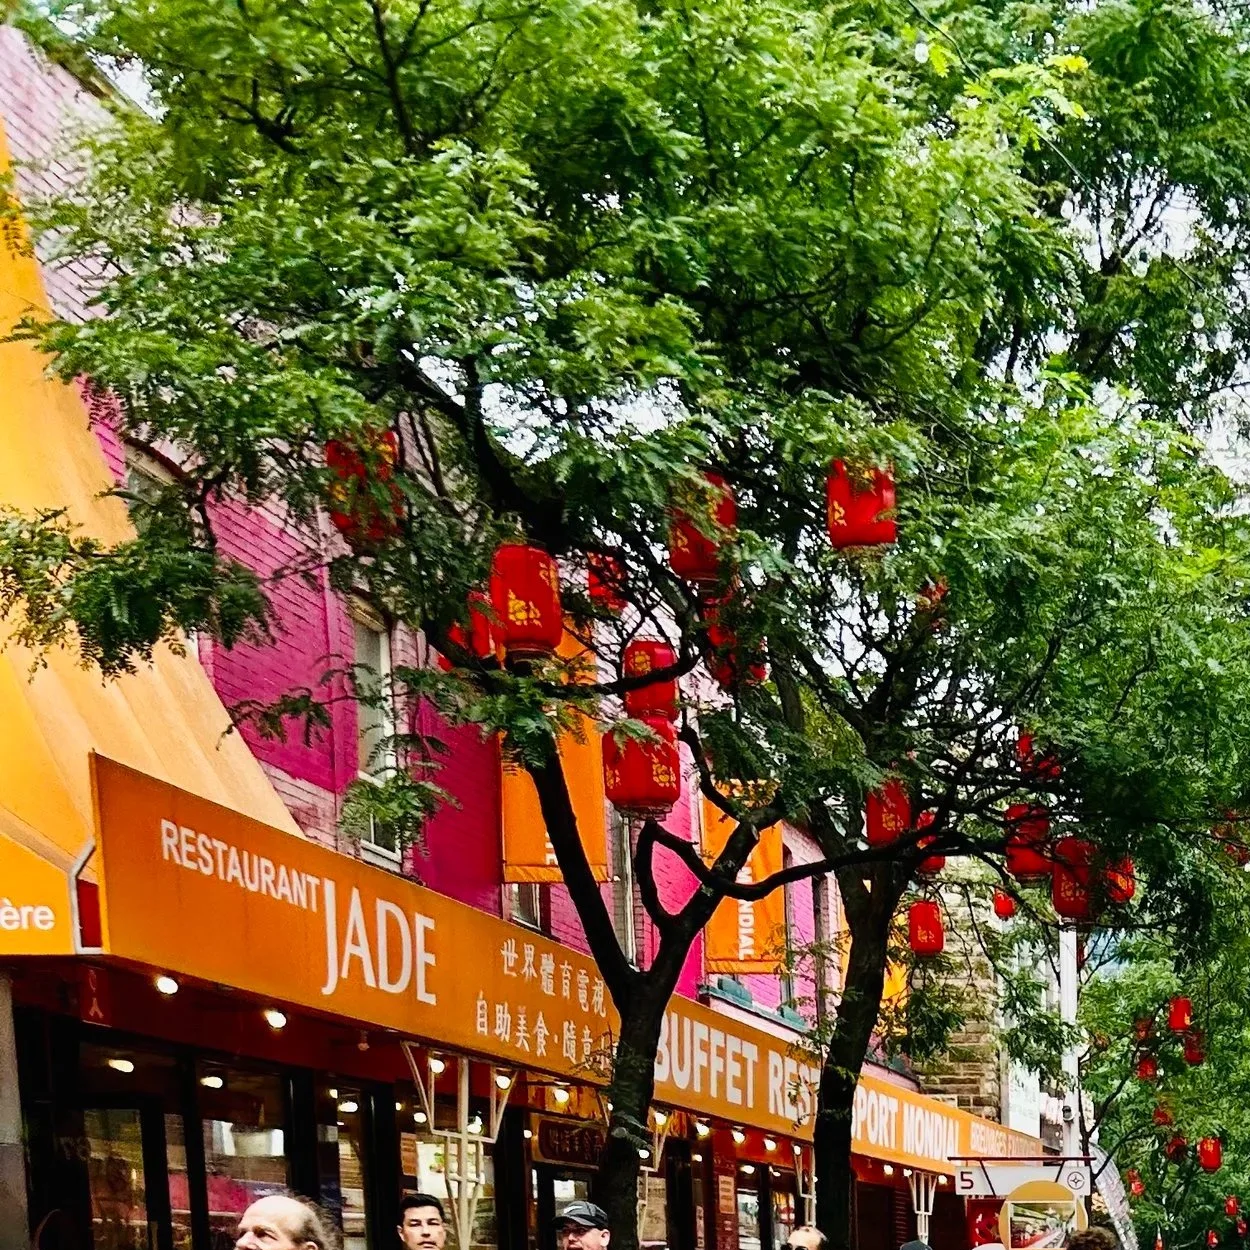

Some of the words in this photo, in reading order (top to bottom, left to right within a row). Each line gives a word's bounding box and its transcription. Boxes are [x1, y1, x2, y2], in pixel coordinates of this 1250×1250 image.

[160, 818, 322, 913] RESTAURANT
[321, 879, 438, 1006] JADE
[654, 1011, 759, 1109] BUFFET
[902, 1101, 960, 1164] MONDIAL
[960, 1171, 975, 1190] 5
